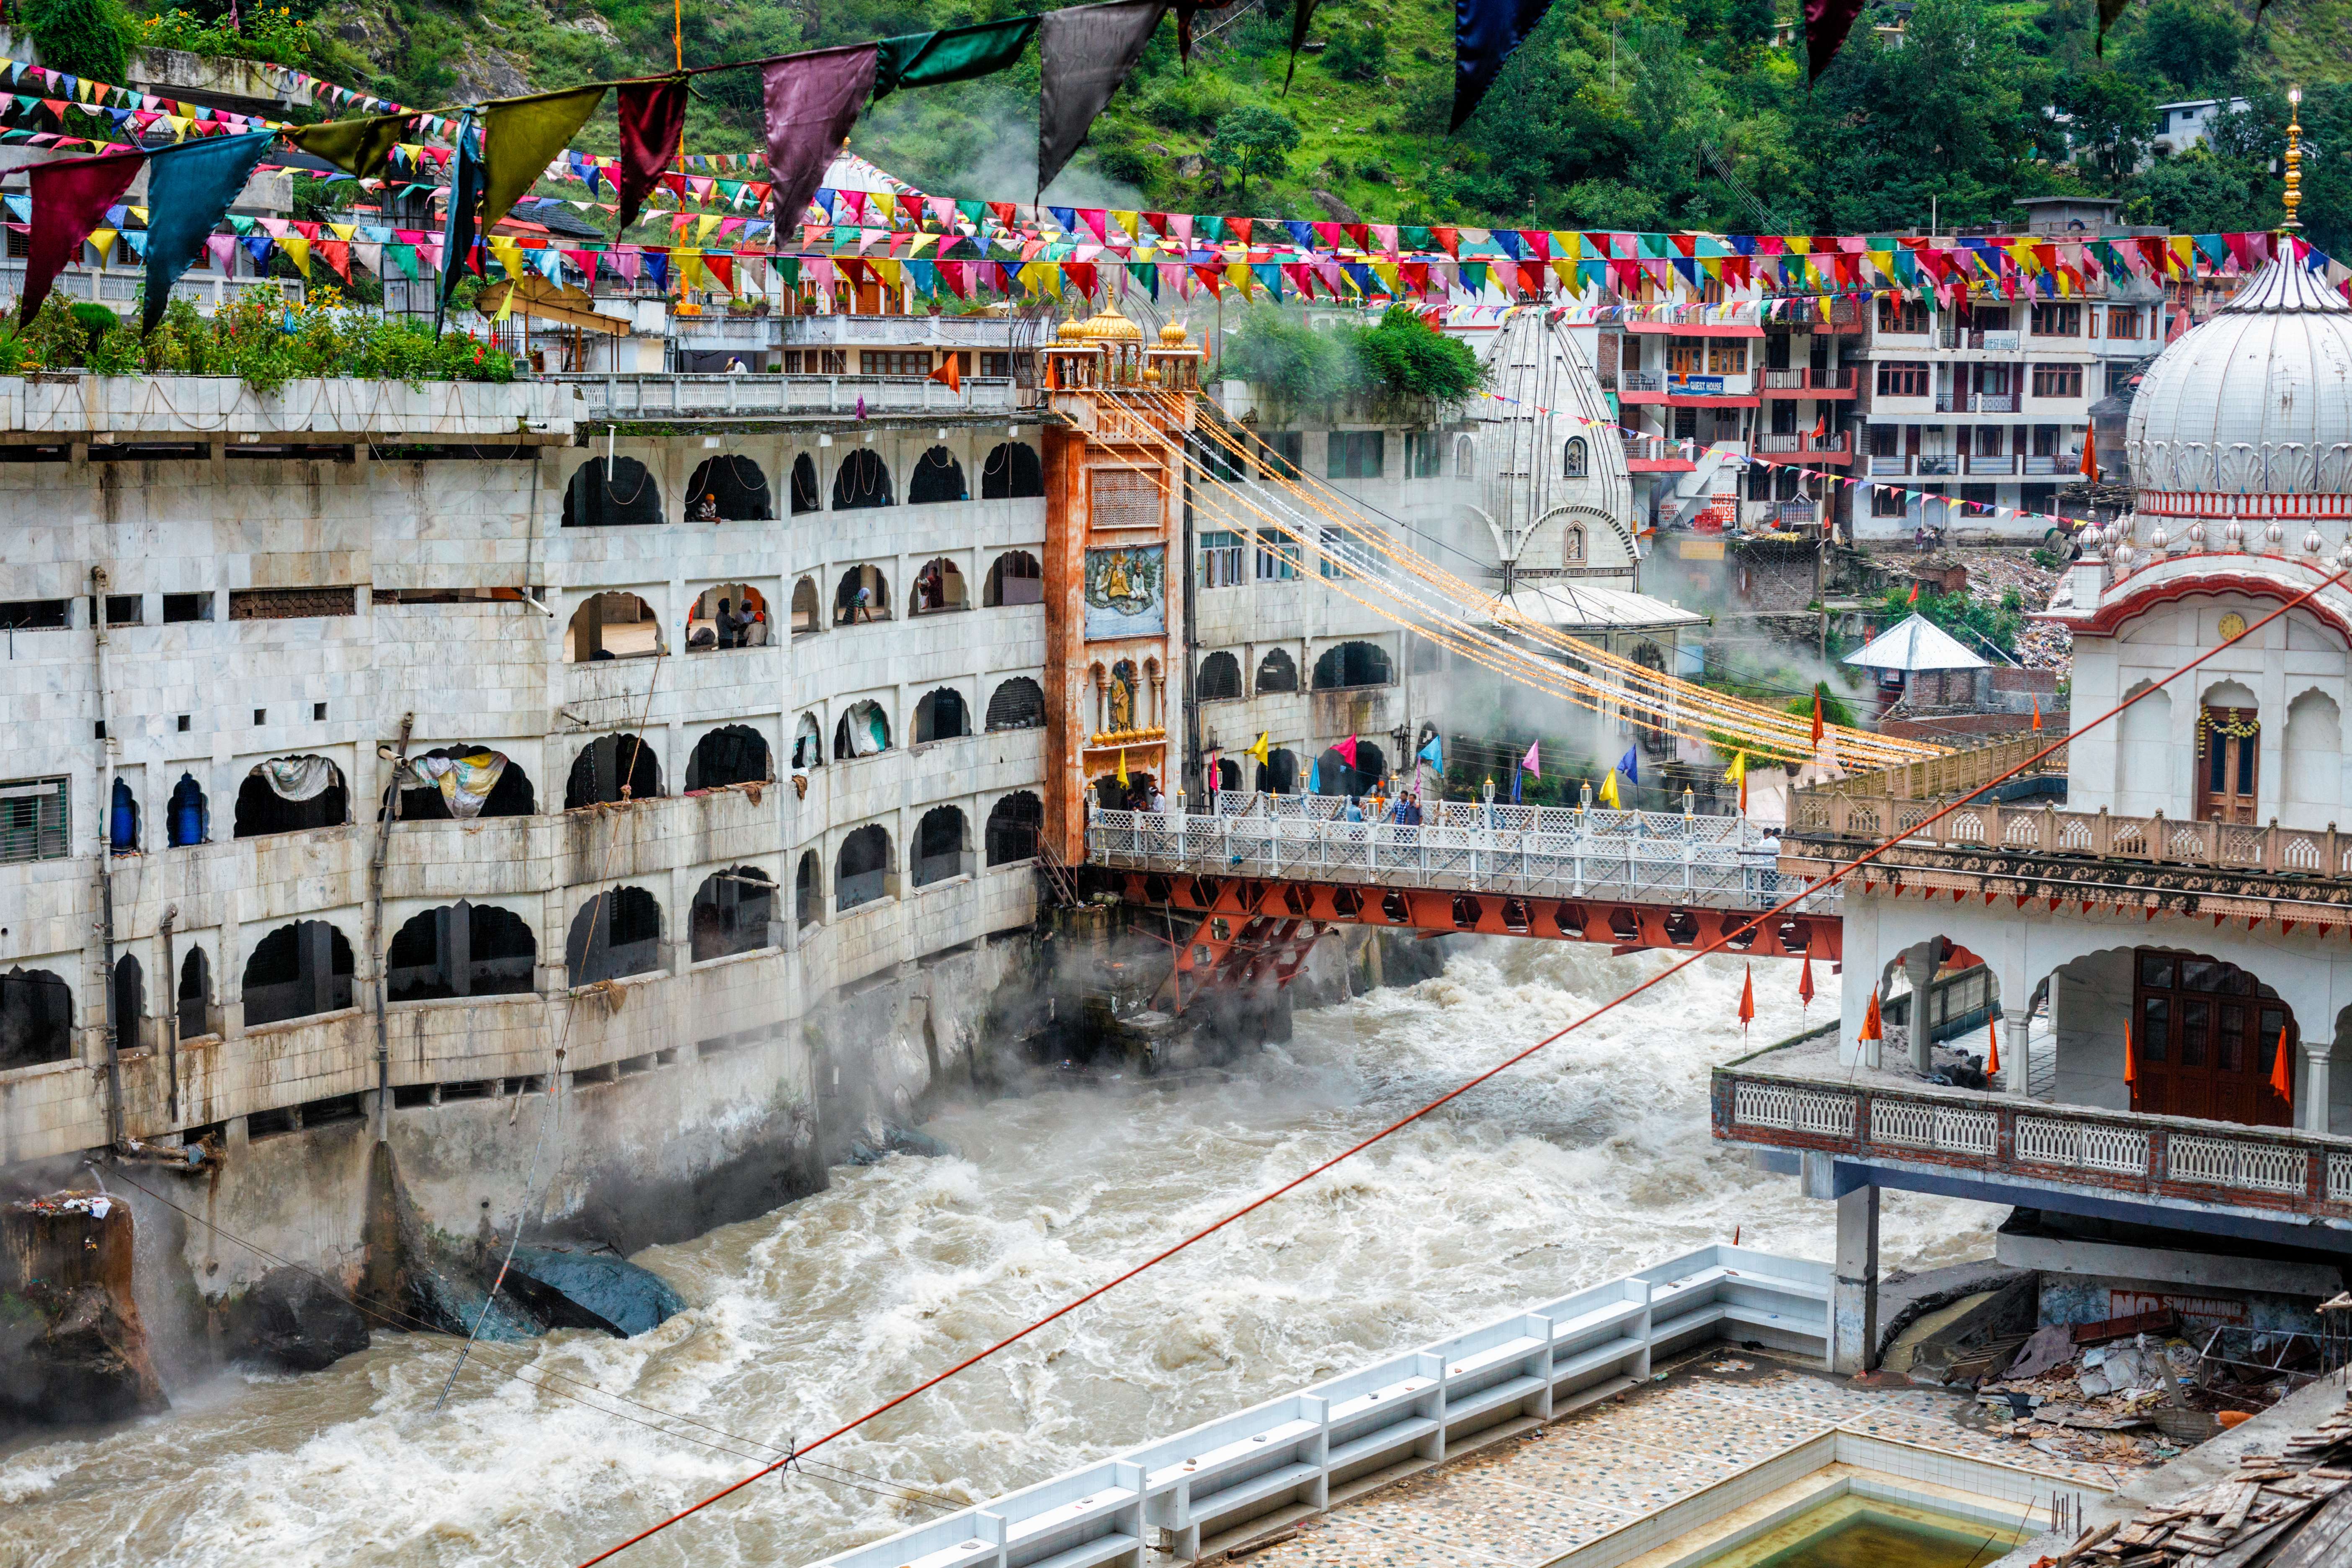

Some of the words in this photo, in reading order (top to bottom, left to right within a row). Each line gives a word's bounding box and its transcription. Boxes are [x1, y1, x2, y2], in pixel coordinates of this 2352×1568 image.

[1985, 338, 1999, 349] GUEST
[2000, 338, 2017, 349] HOUSE
[1690, 381, 1706, 390] GUEST
[1706, 382, 1722, 391] HOUSE
[1711, 493, 1736, 505] GUEST
[1711, 506, 1736, 517] HOUSE
[2112, 1295, 2159, 1319] NO
[2162, 1296, 2242, 1316] SWIMMING
